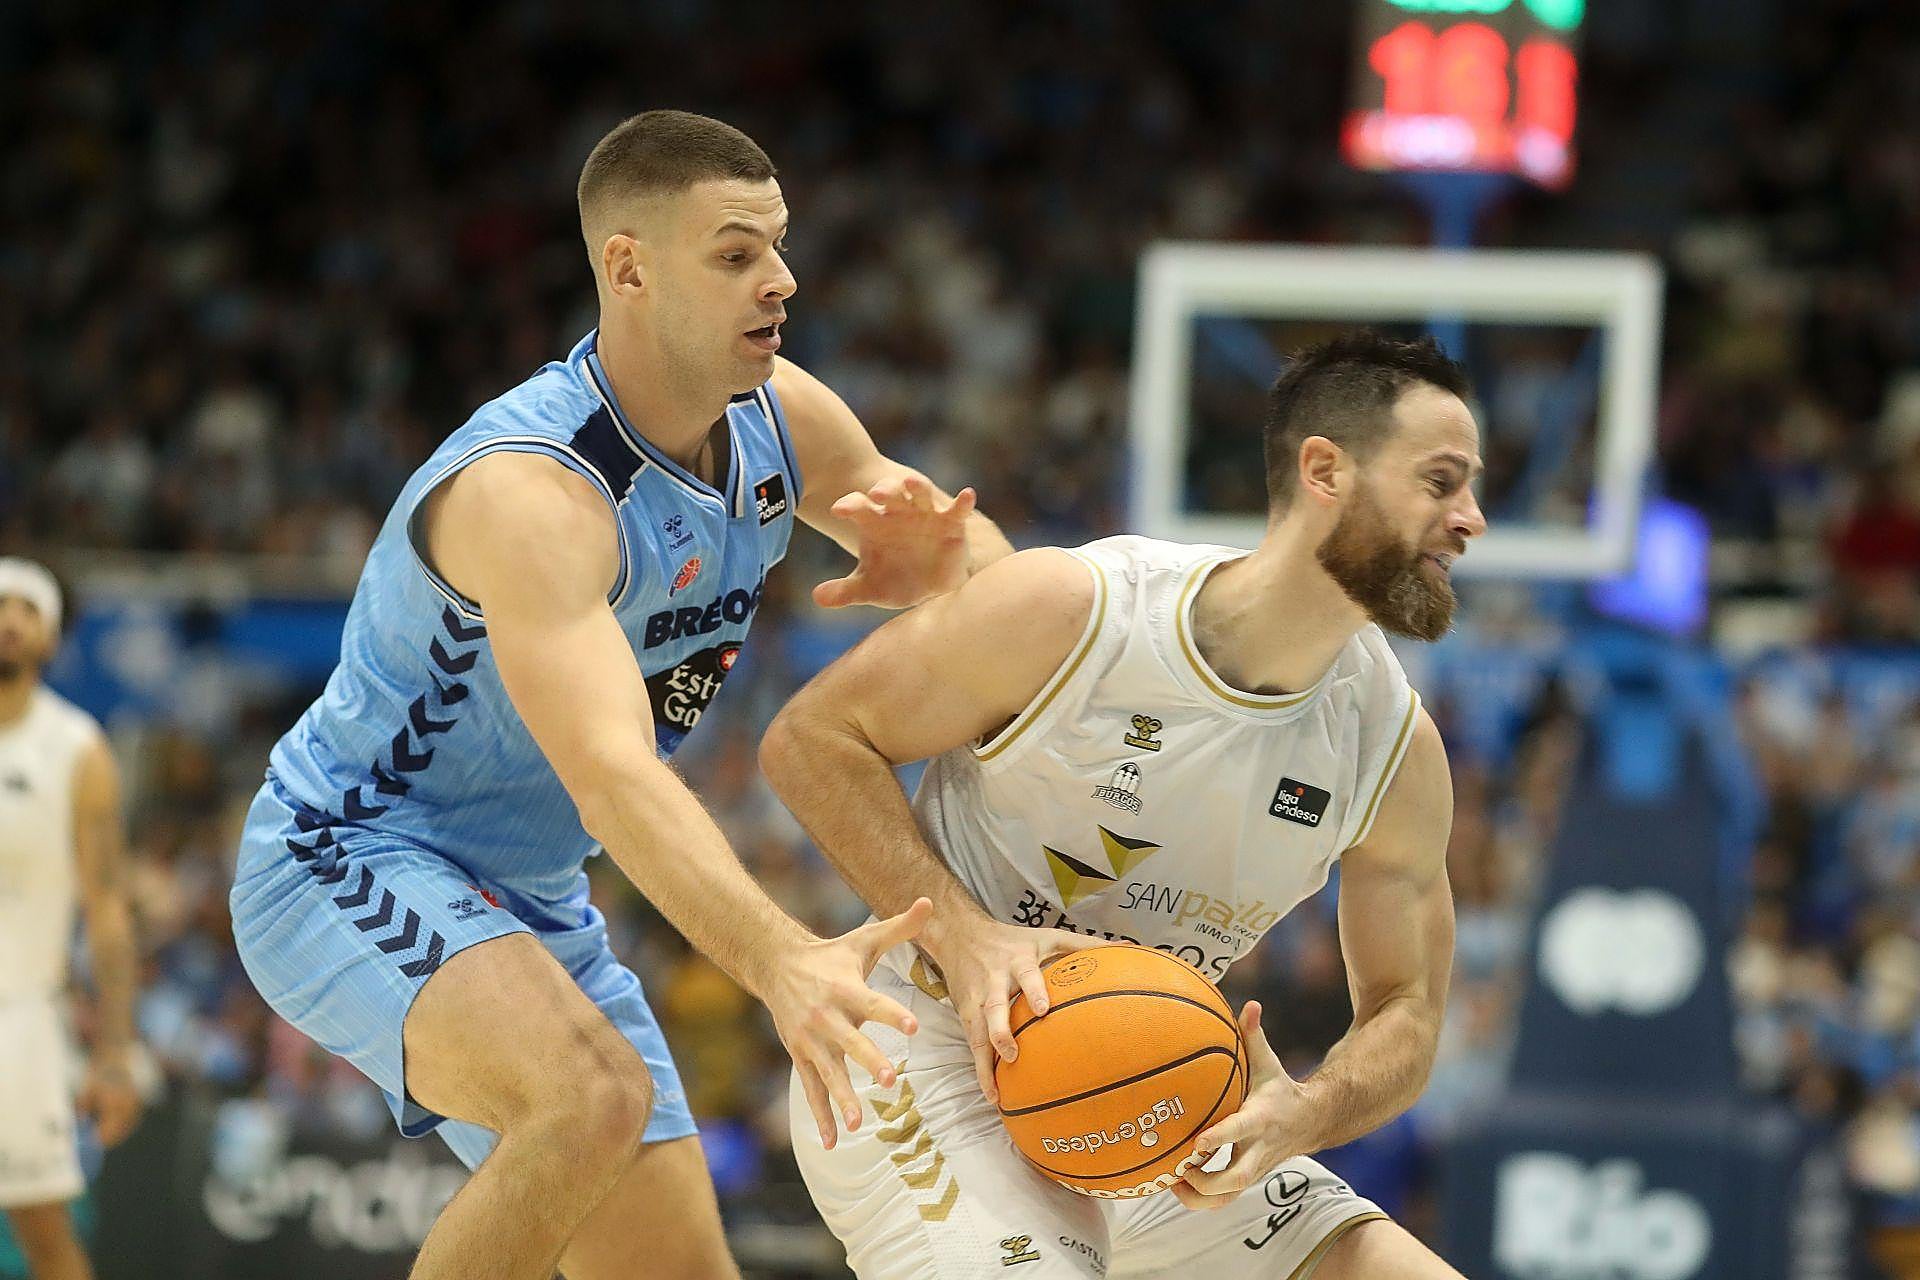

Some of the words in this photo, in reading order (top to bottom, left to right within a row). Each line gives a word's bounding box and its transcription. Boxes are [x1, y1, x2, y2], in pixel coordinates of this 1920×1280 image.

[759, 499, 786, 520] ndesa
[1278, 789, 1300, 805] liga
[1273, 803, 1319, 824] endesa
[1137, 1095, 1186, 1132] liga
[1041, 1121, 1137, 1154] endesa
